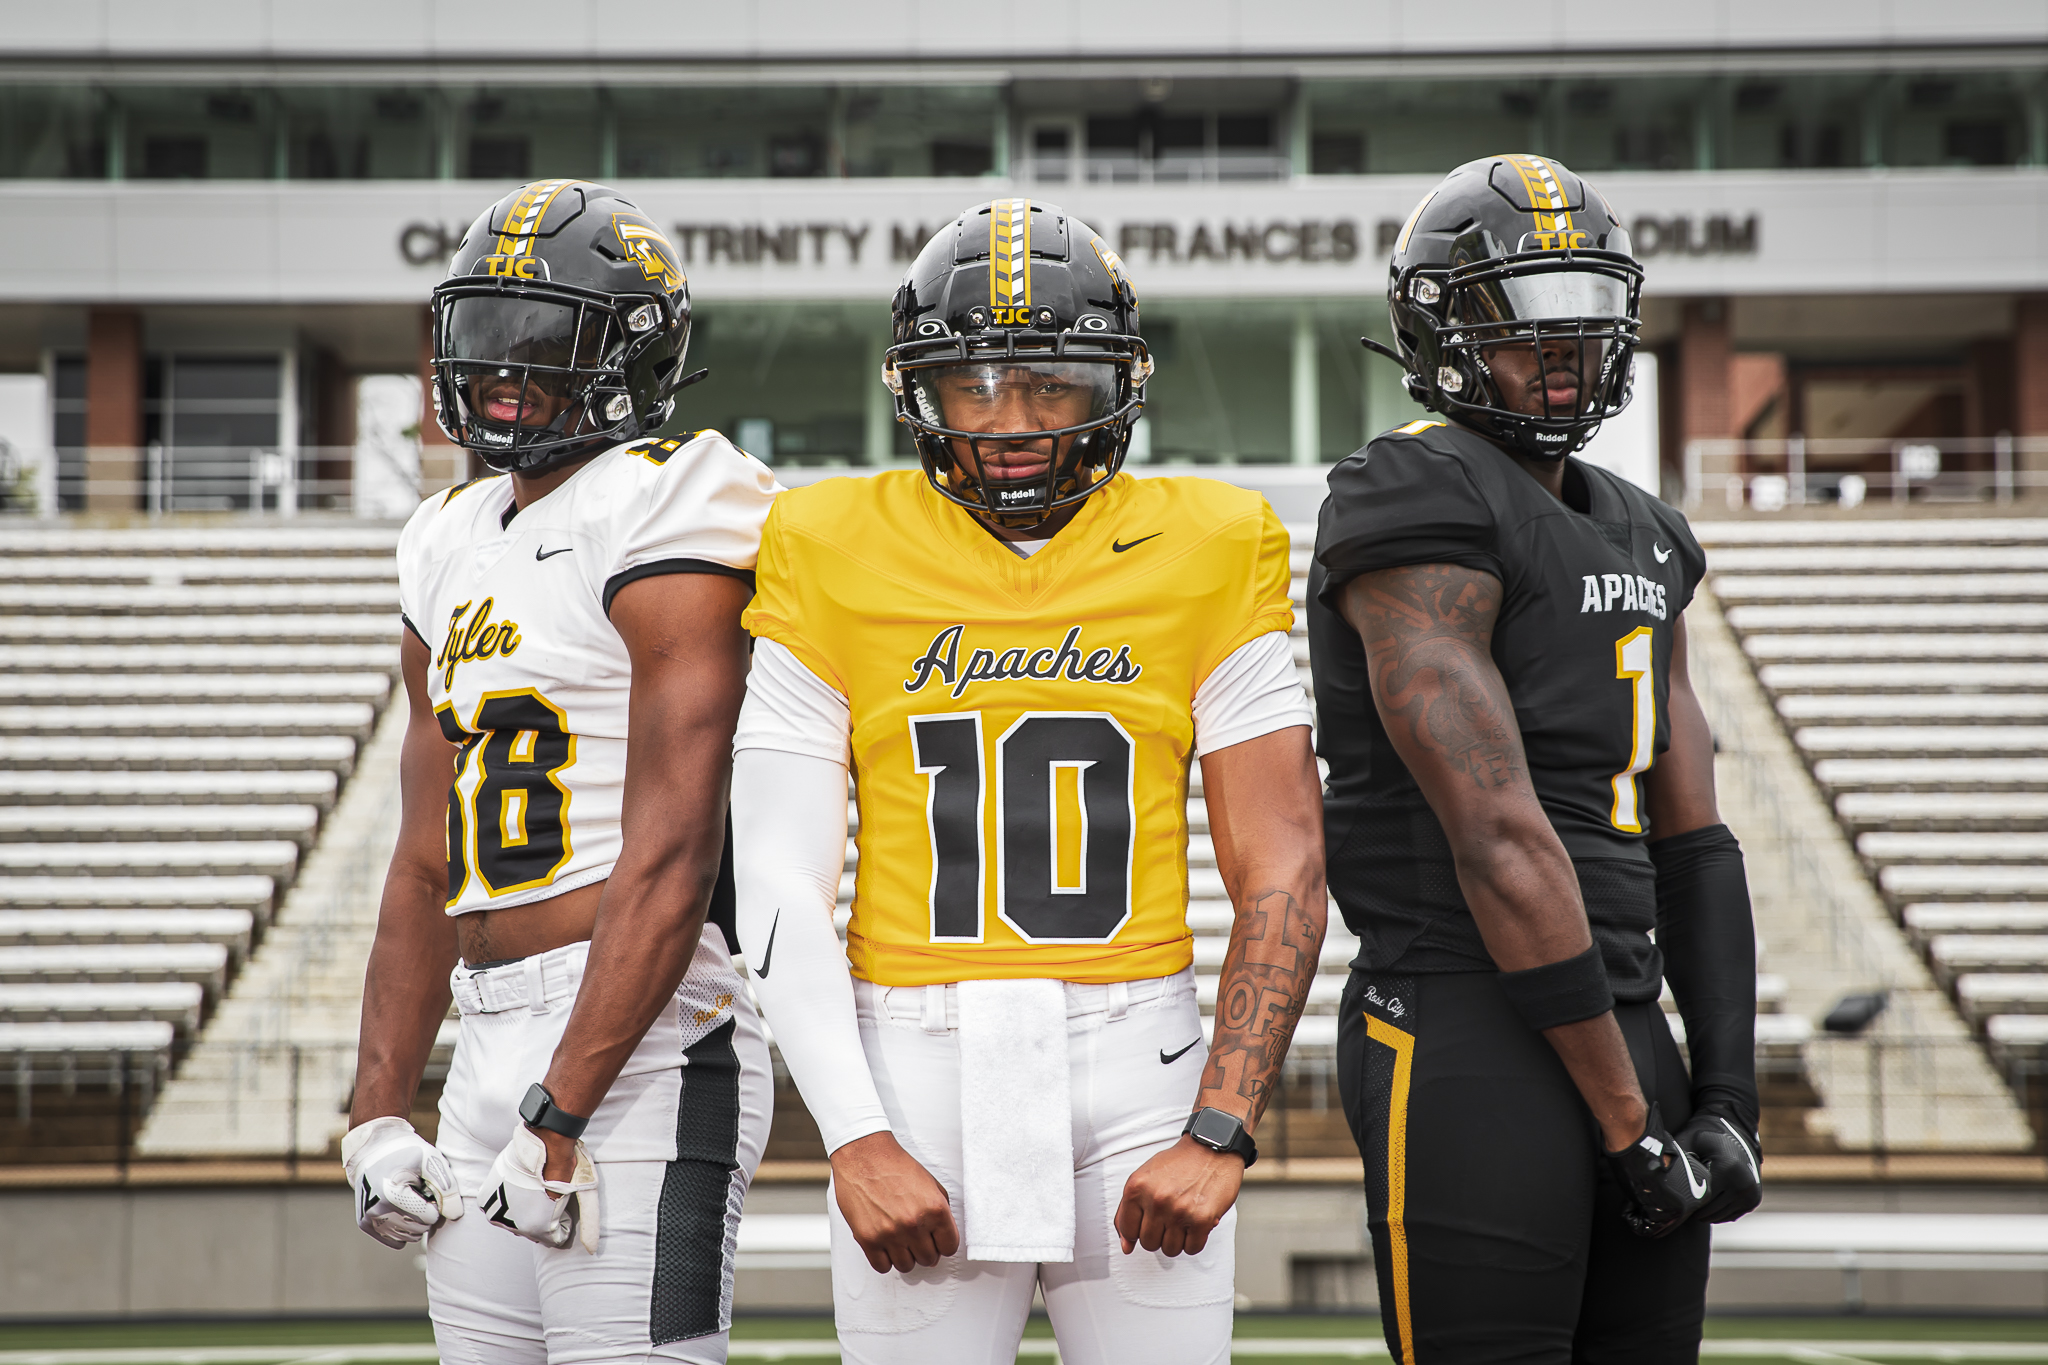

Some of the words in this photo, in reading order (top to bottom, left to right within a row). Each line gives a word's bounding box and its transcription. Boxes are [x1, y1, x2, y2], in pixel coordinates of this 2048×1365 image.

[674, 222, 869, 264] TRINITY
[1119, 219, 1358, 263] FRANCES
[1633, 214, 1760, 258] DIUM
[1534, 232, 1588, 251] TJC
[485, 257, 536, 279] TJC
[992, 308, 1030, 324] TJC
[1536, 432, 1568, 442] Riddell
[1000, 488, 1035, 500] Riddell
[437, 596, 522, 693] Tyler
[903, 624, 1142, 699] Apaches
[1611, 625, 1657, 834] 1
[908, 710, 1136, 945] 10
[1242, 890, 1299, 972] 1
[1223, 979, 1291, 1037] OF
[1364, 985, 1386, 1007] Rose
[1387, 997, 1406, 1018] City
